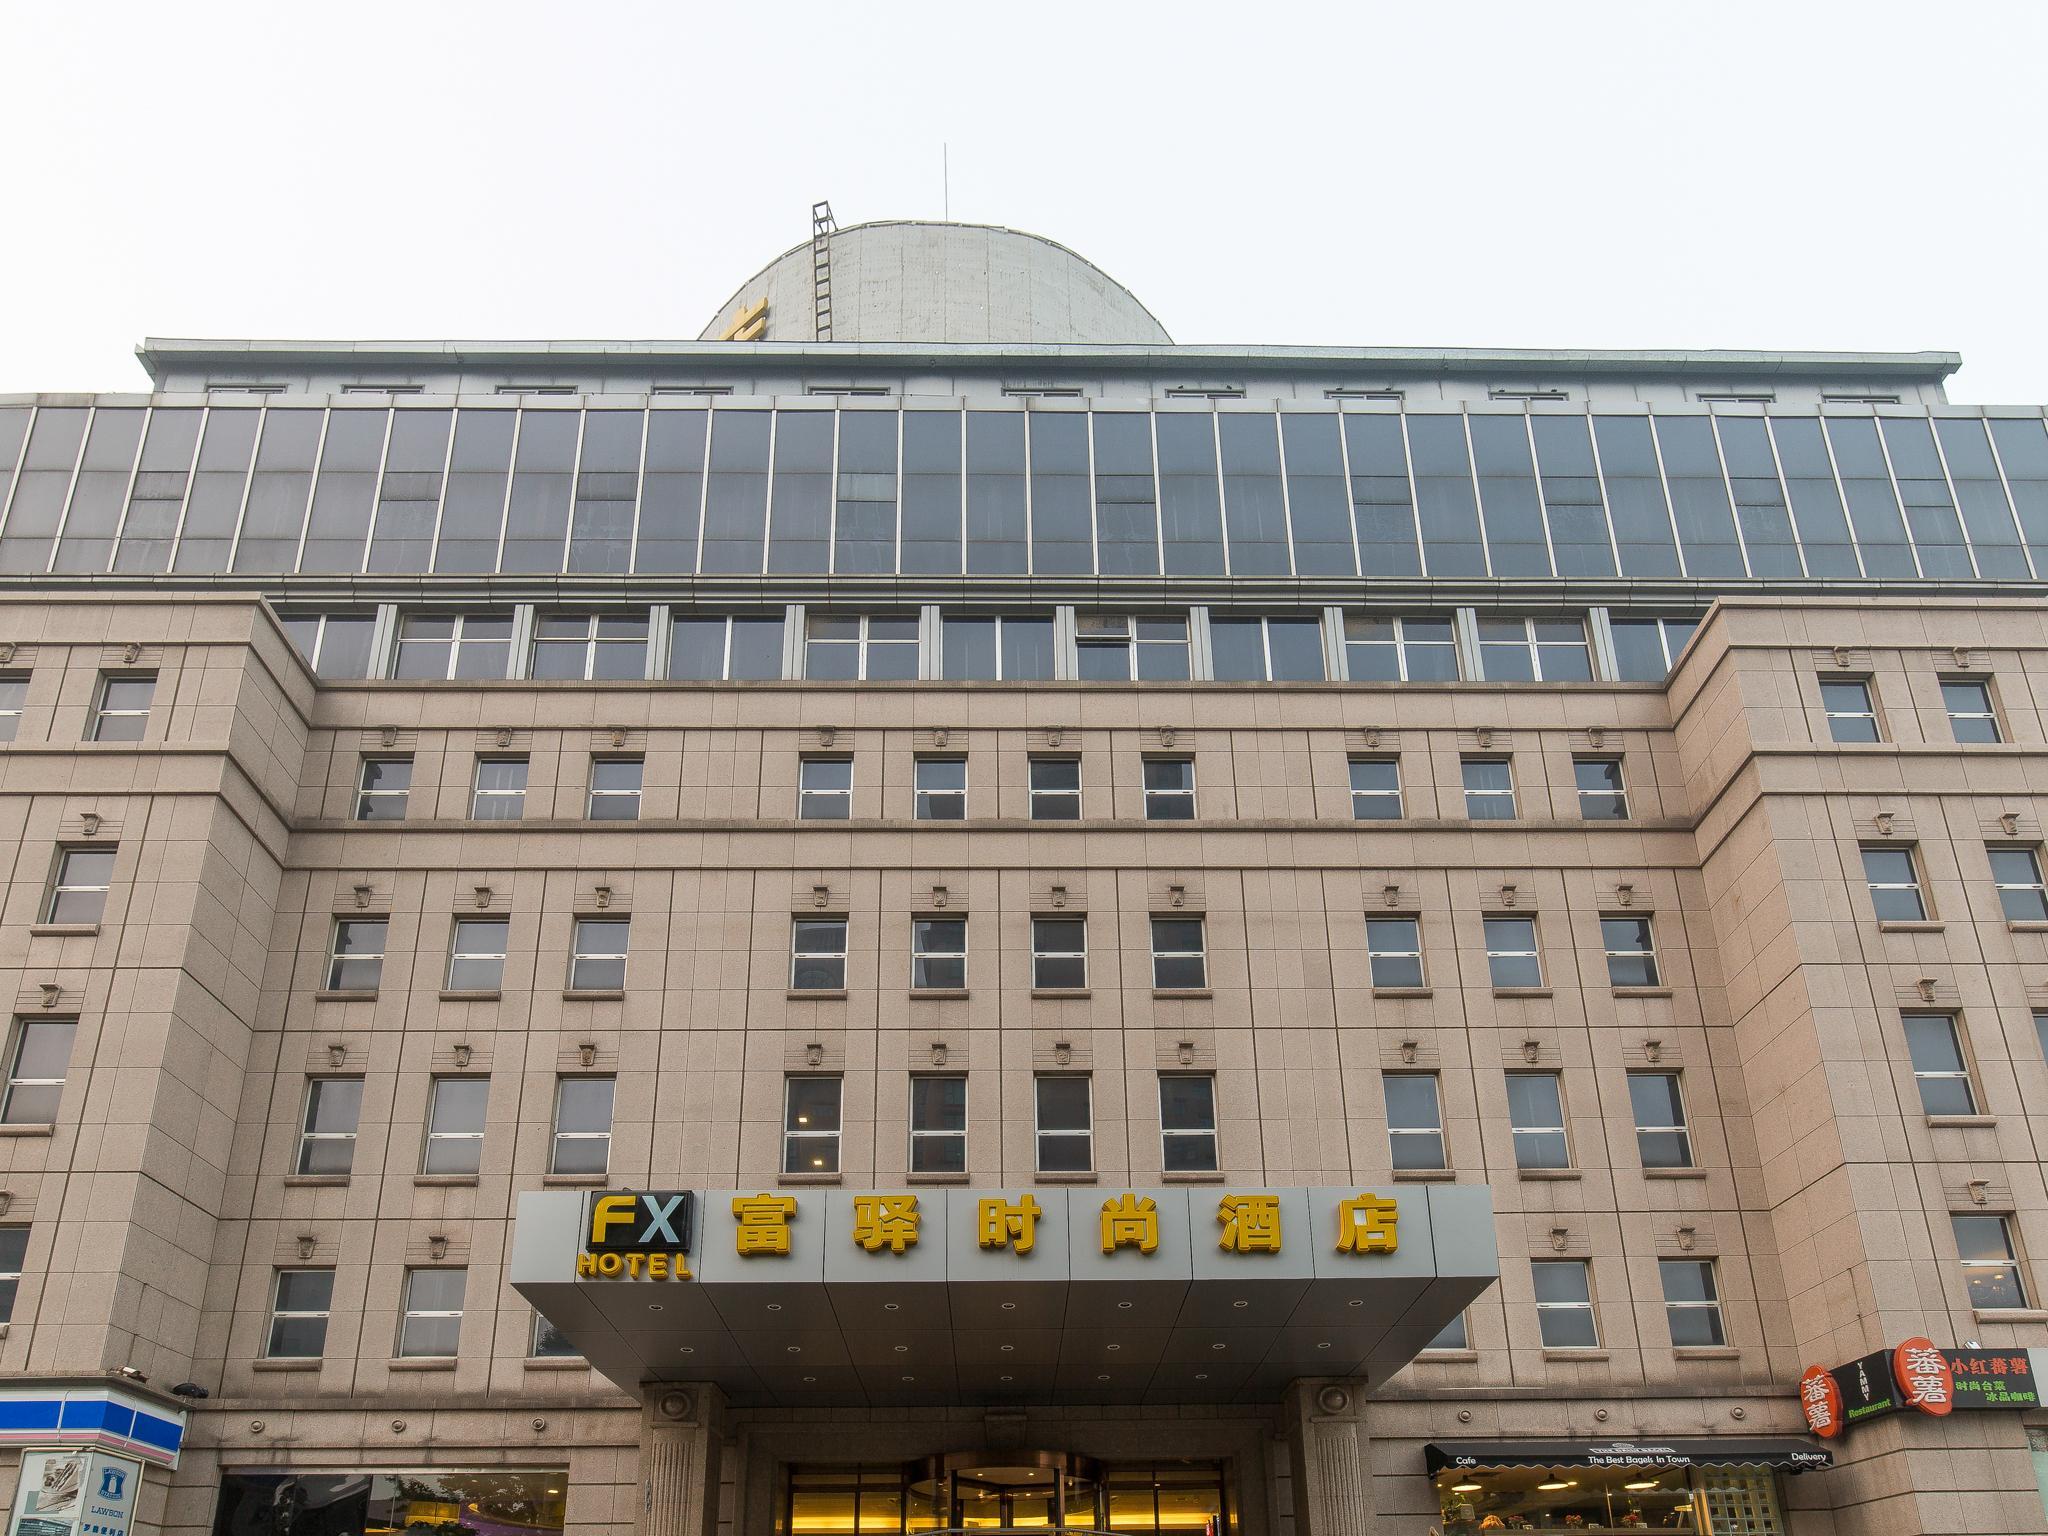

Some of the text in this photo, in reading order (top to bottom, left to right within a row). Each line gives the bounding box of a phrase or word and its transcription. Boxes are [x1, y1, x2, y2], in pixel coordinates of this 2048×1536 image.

[592, 1195, 685, 1243] FX
[731, 1193, 1399, 1257] 富驿时尚酒店
[577, 1253, 694, 1281] HOTEL
[1857, 1361, 1870, 1402] YAMMY
[1848, 1398, 1892, 1418] Restaurant
[1456, 1456, 1476, 1464] Cafe
[1588, 1455, 1691, 1464] The Best Bagels In Town
[1791, 1452, 1827, 1462] Delivery
[91, 1506, 124, 1518] LAWSON
